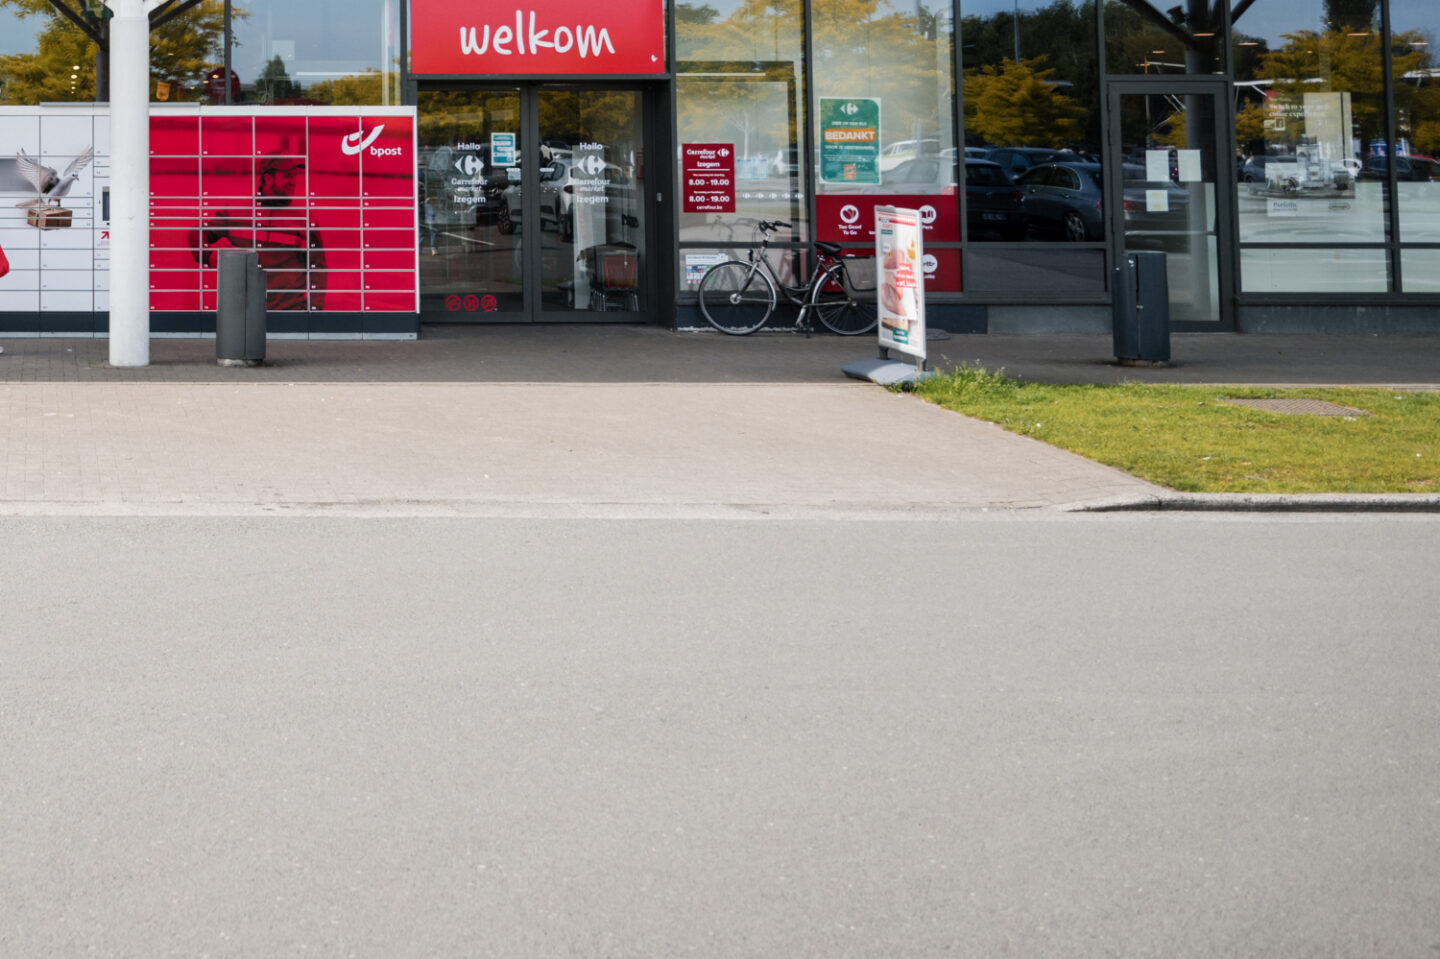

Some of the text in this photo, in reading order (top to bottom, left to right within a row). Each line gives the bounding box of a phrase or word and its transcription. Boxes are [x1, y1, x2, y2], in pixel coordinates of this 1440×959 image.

[460, 9, 615, 58] welkom
[824, 131, 876, 140] BEDANKT
[457, 142, 481, 151] Hallo
[579, 142, 603, 151] Hallo
[370, 145, 402, 158] bpost
[451, 177, 488, 185] Carrefour
[573, 177, 611, 185] Carrefour
[453, 195, 487, 205] Izegem
[576, 195, 609, 205] Izegem
